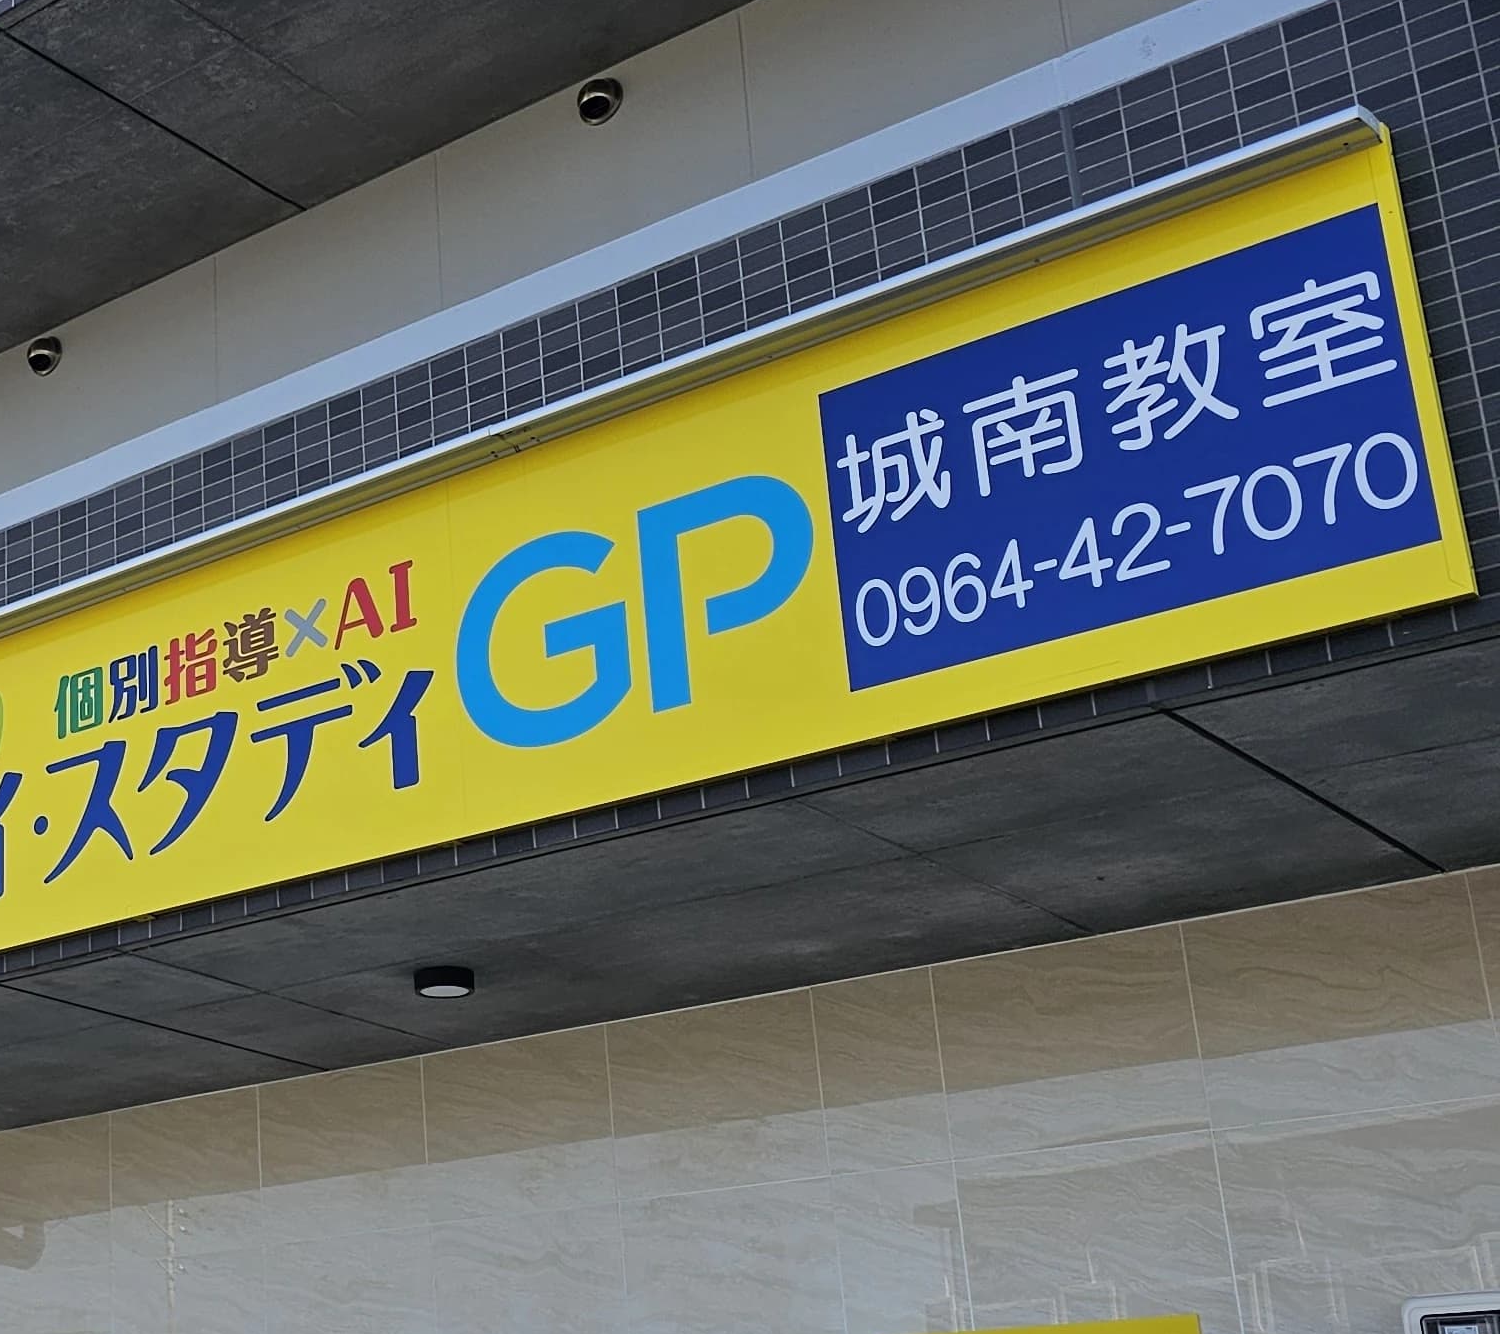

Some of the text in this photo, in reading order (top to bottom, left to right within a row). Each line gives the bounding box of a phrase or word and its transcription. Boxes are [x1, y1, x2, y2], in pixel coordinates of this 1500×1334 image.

[836, 270, 1397, 534] 城南教室
[54, 559, 418, 740] 個別指導×AI
[455, 474, 814, 749] GP
[854, 432, 1418, 648] 0964-42-7070
